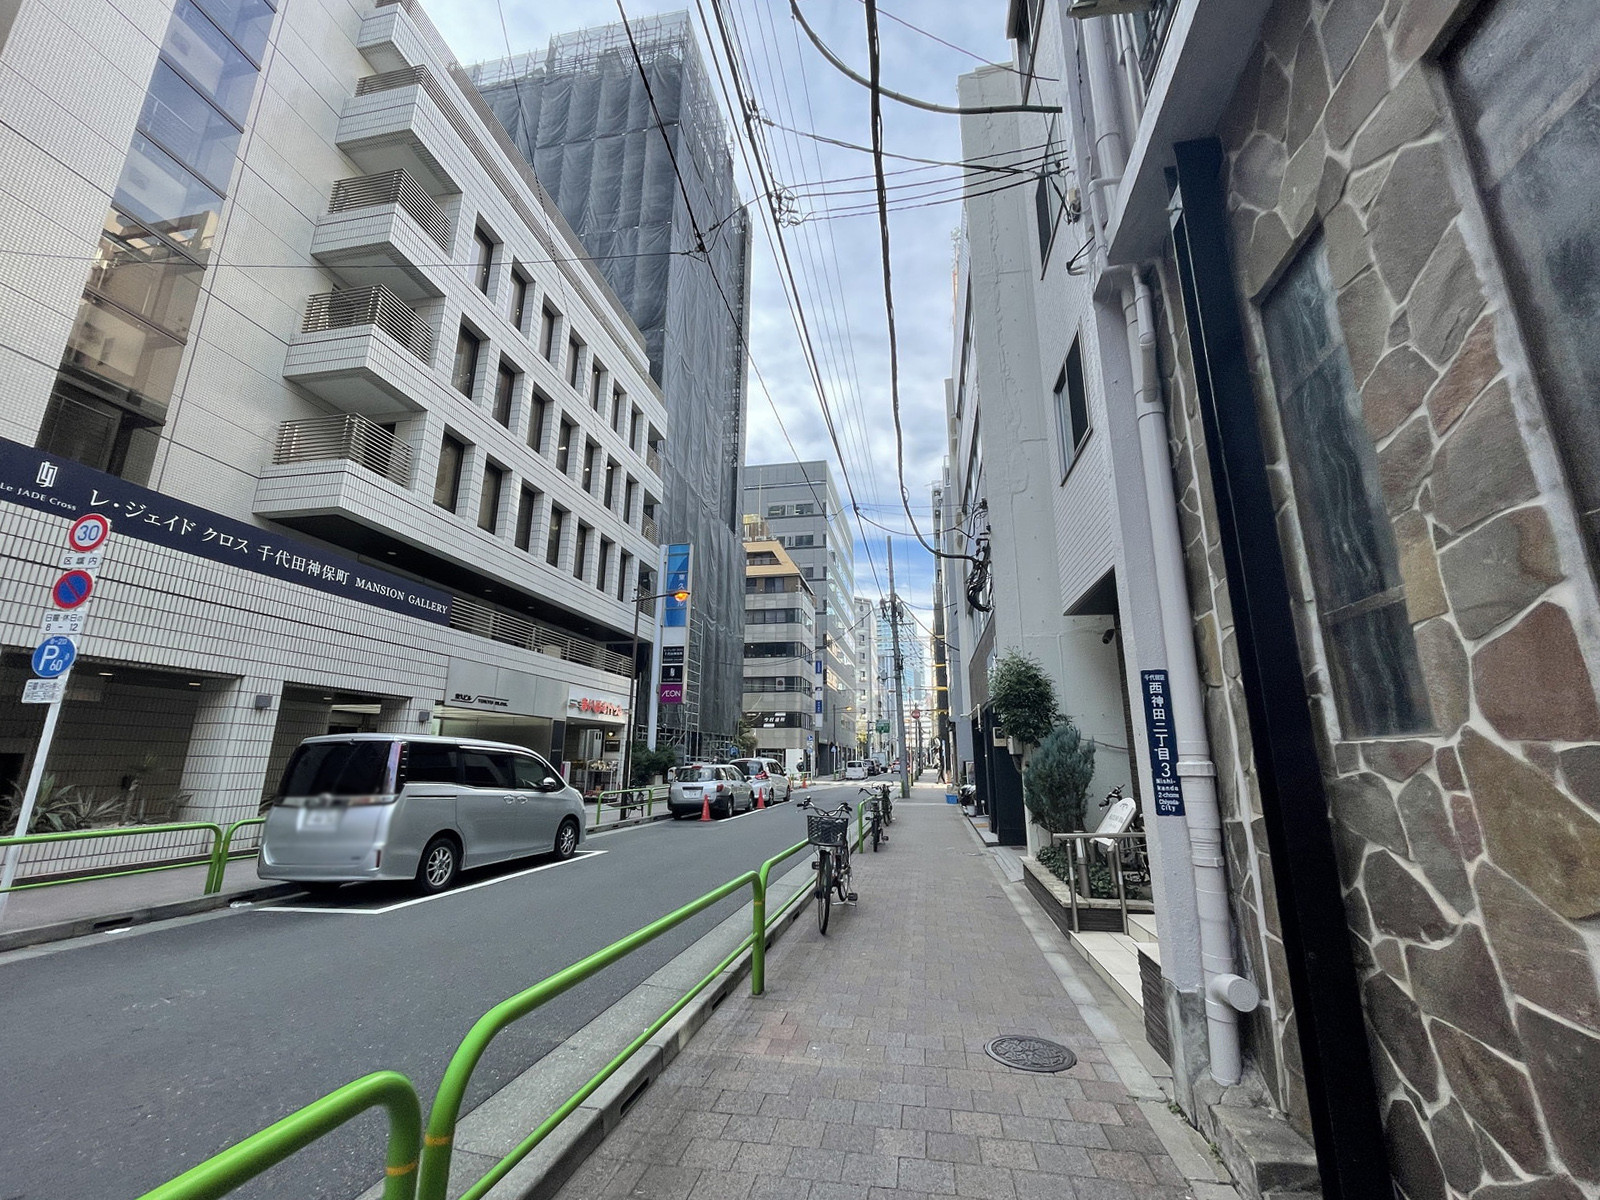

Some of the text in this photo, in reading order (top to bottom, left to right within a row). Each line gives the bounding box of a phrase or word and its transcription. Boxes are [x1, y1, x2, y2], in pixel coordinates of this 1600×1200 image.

[0, 482, 77, 511] Le JADE Cross
[77, 524, 100, 541] 30
[90, 489, 448, 614] レ・ジェイド クロス 千代田神保町 MANSION GALLERY
